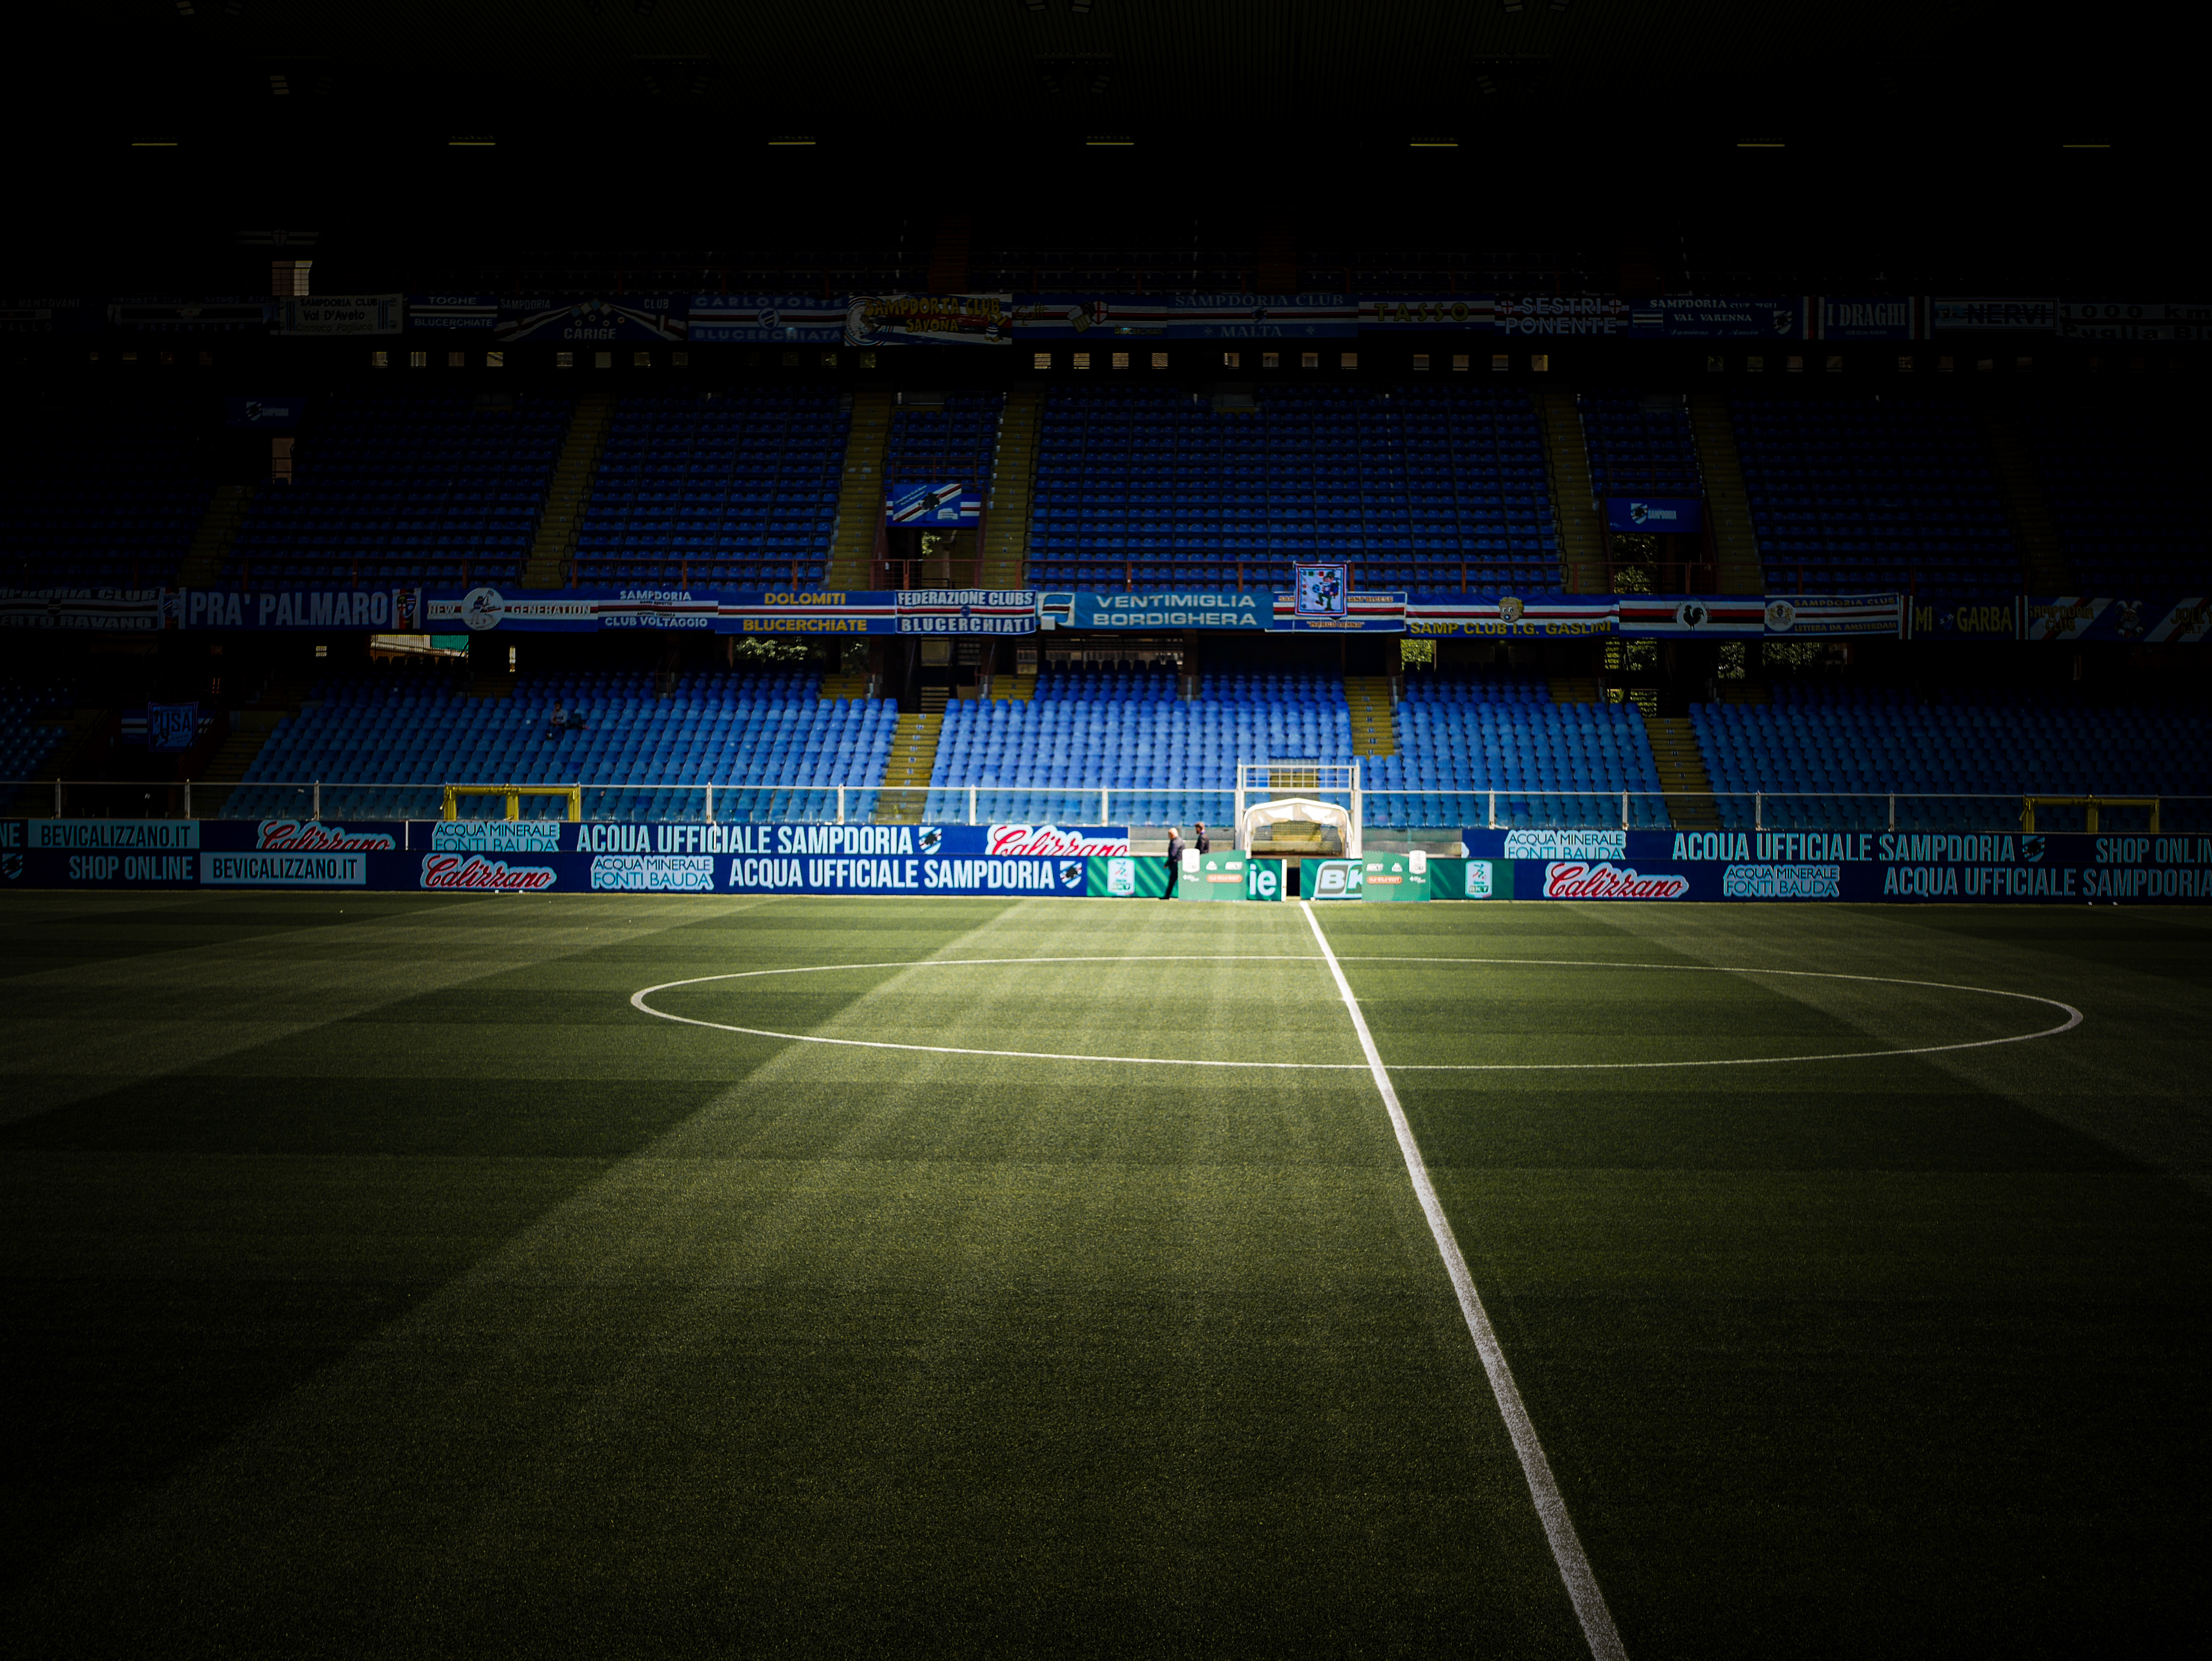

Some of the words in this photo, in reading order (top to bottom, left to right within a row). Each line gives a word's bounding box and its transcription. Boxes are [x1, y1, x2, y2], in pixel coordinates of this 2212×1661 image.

[18, 298, 80, 307] MANTOVANI
[300, 299, 351, 307] SAMPDORIA
[356, 298, 377, 306] CLUB
[500, 299, 551, 310] SAMPDORIA
[644, 299, 669, 309] CLUB
[695, 297, 843, 307] CARLOFORTE
[864, 297, 960, 316] SAMPDORIA
[965, 297, 1001, 316] CLUB
[1175, 295, 1288, 307] SAMPDORIA
[1296, 294, 1343, 306] CLUB
[1521, 297, 1602, 315] SESTRI
[1650, 300, 1727, 308] SAMPDORIA
[303, 310, 319, 321] Val
[324, 309, 365, 321] D'Aveto
[1374, 303, 1469, 322] TASSO
[1828, 304, 1834, 326] I
[1839, 303, 1907, 327] DRAGHI
[1968, 304, 2047, 325] NERVI
[2060, 304, 2143, 318] 1000
[2164, 304, 2211, 319] km
[0, 323, 52, 331] ALLO
[414, 318, 493, 327] BLUCERCHIATE
[906, 318, 959, 332] SAVONA
[1505, 317, 1617, 334] PONENTE
[564, 328, 616, 339] CARIGE
[1221, 326, 1282, 337] MALTA
[98, 589, 156, 601] CLUB
[620, 590, 692, 601] SAMPDORIA
[764, 593, 846, 605] DOLOMITI
[898, 592, 985, 605] FEDERAZIONE
[989, 593, 1032, 606] CLUBS
[1096, 594, 1256, 608] VENTIMIGLIA
[1867, 598, 1895, 606] CLUB
[190, 592, 250, 625] PRA'
[259, 592, 388, 626] PALMARO
[428, 606, 455, 615] NEW
[511, 606, 591, 616] GENERATION
[60, 616, 151, 629] RAVANO
[605, 617, 637, 627] CLUB
[641, 617, 708, 628] VOLTAGGIO
[901, 618, 1031, 633] BLUCERCHIATI
[1093, 613, 1257, 626] BORDIGHERA
[1915, 606, 1932, 632] MI
[1957, 606, 2013, 632] GARBA
[743, 620, 867, 632] BLUCERCHIATE
[1410, 622, 1458, 634] SAMP
[1463, 622, 1507, 634] CLUB
[1545, 620, 1611, 635] GASLINI
[1794, 623, 1827, 632] LETTERA
[1830, 623, 1842, 632] DA
[1844, 621, 1896, 630] AMSTERDAM
[2045, 619, 2077, 633] CLUB
[159, 712, 191, 732] USA
[41, 825, 191, 847] BEVICALIZZANO.IT
[435, 824, 488, 837] ACQUA
[490, 824, 556, 837] MINERALE
[435, 839, 487, 851] FONTI
[494, 839, 555, 851] BAUDA
[577, 824, 651, 852] ACQUA
[658, 825, 771, 854] UFFICIALE
[778, 826, 913, 855] SAMPDORIA
[1509, 833, 1555, 846] ACQUA
[1560, 833, 1622, 846] MINERALE
[1509, 847, 1557, 859] FONTI
[1565, 847, 1624, 859] BAUDA
[1672, 832, 1749, 860] ACQUA
[1757, 833, 1872, 861] UFFICIALE
[1880, 834, 2015, 862] SAMPDORIA
[2095, 838, 2149, 863] SHOP
[69, 855, 119, 880] SHOP
[125, 855, 193, 881] ONLINE
[213, 858, 357, 879] BEVICALIZZANO.IT
[594, 858, 642, 871] ACQUA
[646, 858, 711, 870] MINERALE
[425, 855, 551, 888] Calizzano
[729, 858, 803, 888] ACQUA
[809, 859, 919, 888] UFFICIALE
[924, 860, 1055, 889] SAMPDORIA
[1726, 868, 1773, 880] ACQUA
[1777, 868, 1837, 880] MINERALE
[594, 872, 644, 886] FONTI
[650, 872, 710, 886] BAUDA
[1250, 863, 1277, 896] ie
[1548, 863, 1684, 897] Calizzano
[1884, 867, 1958, 897] ACQUA
[1965, 868, 2076, 896] UFFICIALE
[2082, 869, 2212, 897] SAMPDORIA
[1727, 881, 1775, 894] FONTI
[1781, 881, 1836, 895] BAUDA
